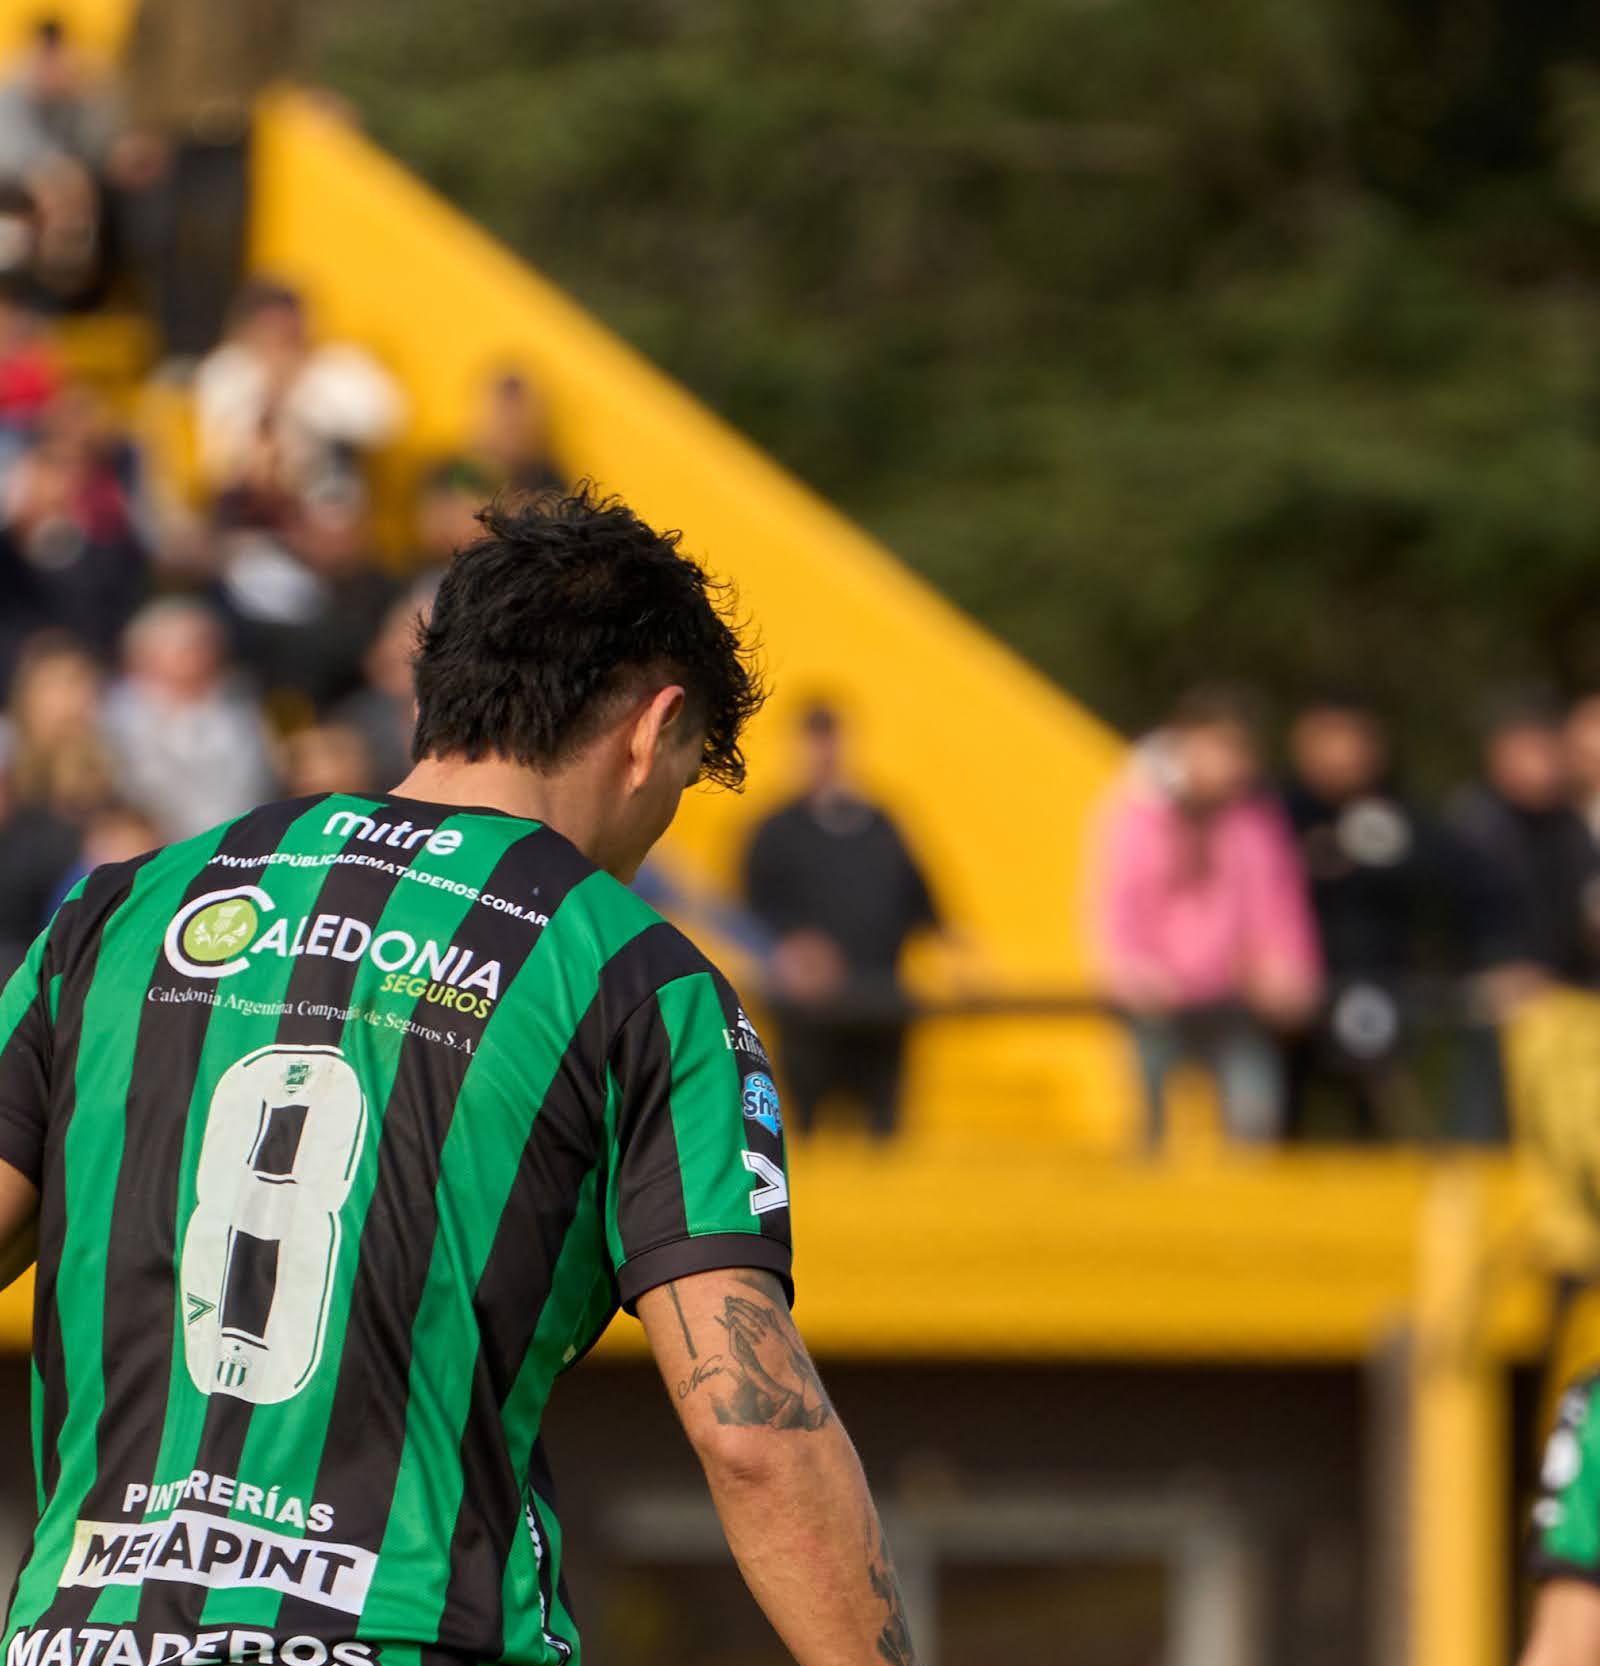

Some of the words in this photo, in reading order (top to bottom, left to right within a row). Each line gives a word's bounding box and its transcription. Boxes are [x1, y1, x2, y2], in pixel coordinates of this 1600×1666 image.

[322, 811, 463, 856] mitre
[164, 885, 501, 999] CALEDONIA
[148, 986, 222, 1007] Caledonia
[224, 993, 292, 1016] Argentina
[364, 1009, 382, 1027] de
[383, 1012, 442, 1043] Seguros
[443, 1030, 476, 1056] S.A.
[380, 973, 492, 1019] SEGUROS
[181, 1044, 367, 1405] 8
[122, 1470, 334, 1532] PINTRERÍAS
[78, 1522, 355, 1595] MEAPINT
